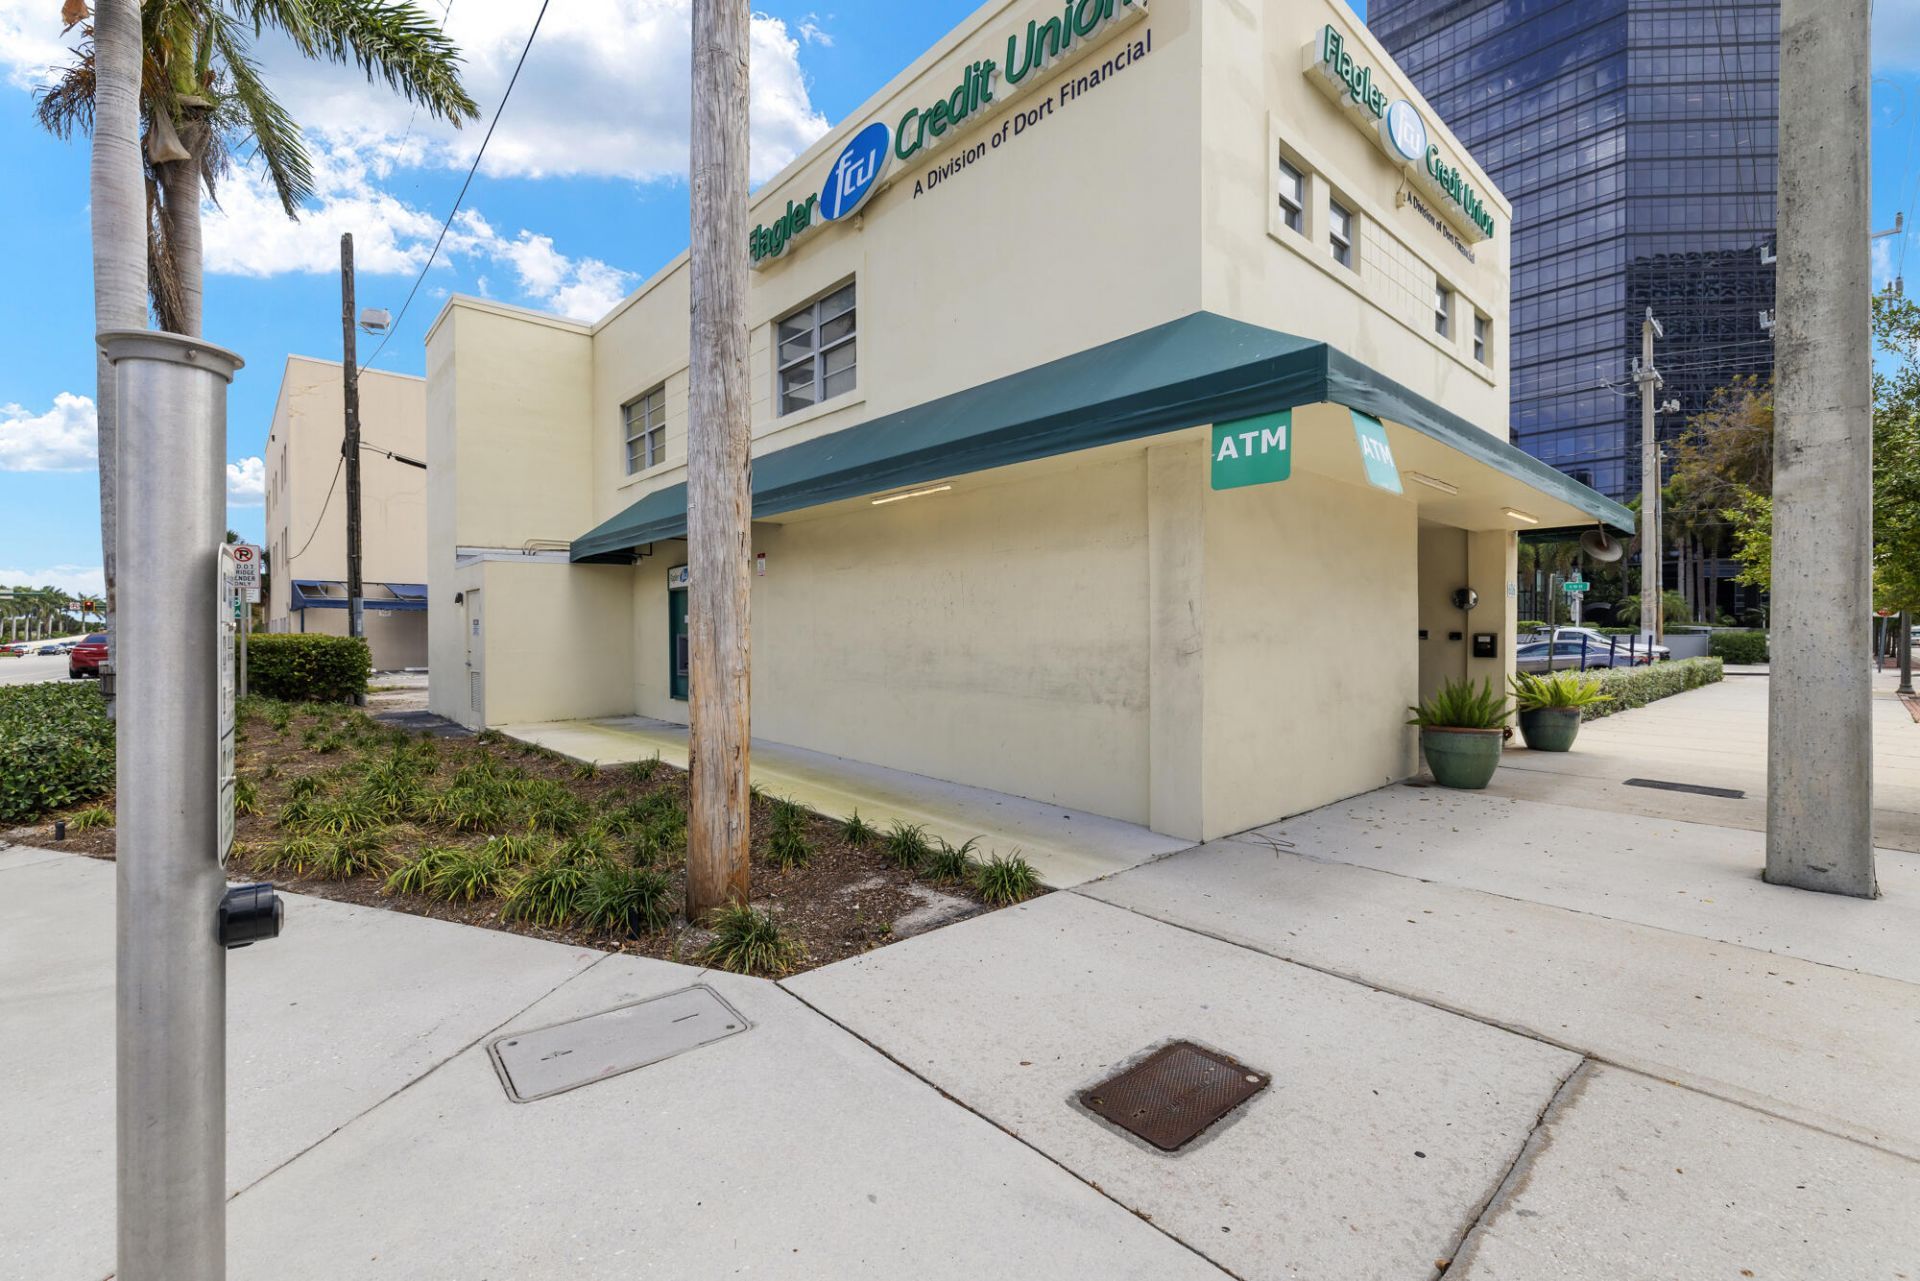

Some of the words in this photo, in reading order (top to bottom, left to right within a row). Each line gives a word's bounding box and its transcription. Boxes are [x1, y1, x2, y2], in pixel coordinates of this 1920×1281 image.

[832, 149, 876, 219] fcu
[894, 58, 996, 160] Credit
[913, 179, 924, 199] A
[927, 142, 986, 190] Division
[991, 120, 1010, 149] of
[1014, 97, 1053, 136] Dort
[1060, 28, 1151, 107] Financial
[1323, 24, 1388, 119] Flagler
[1426, 144, 1463, 206] Credit
[1464, 183, 1495, 239] Union
[1216, 425, 1287, 461] ATM
[1361, 434, 1394, 467] ATM
